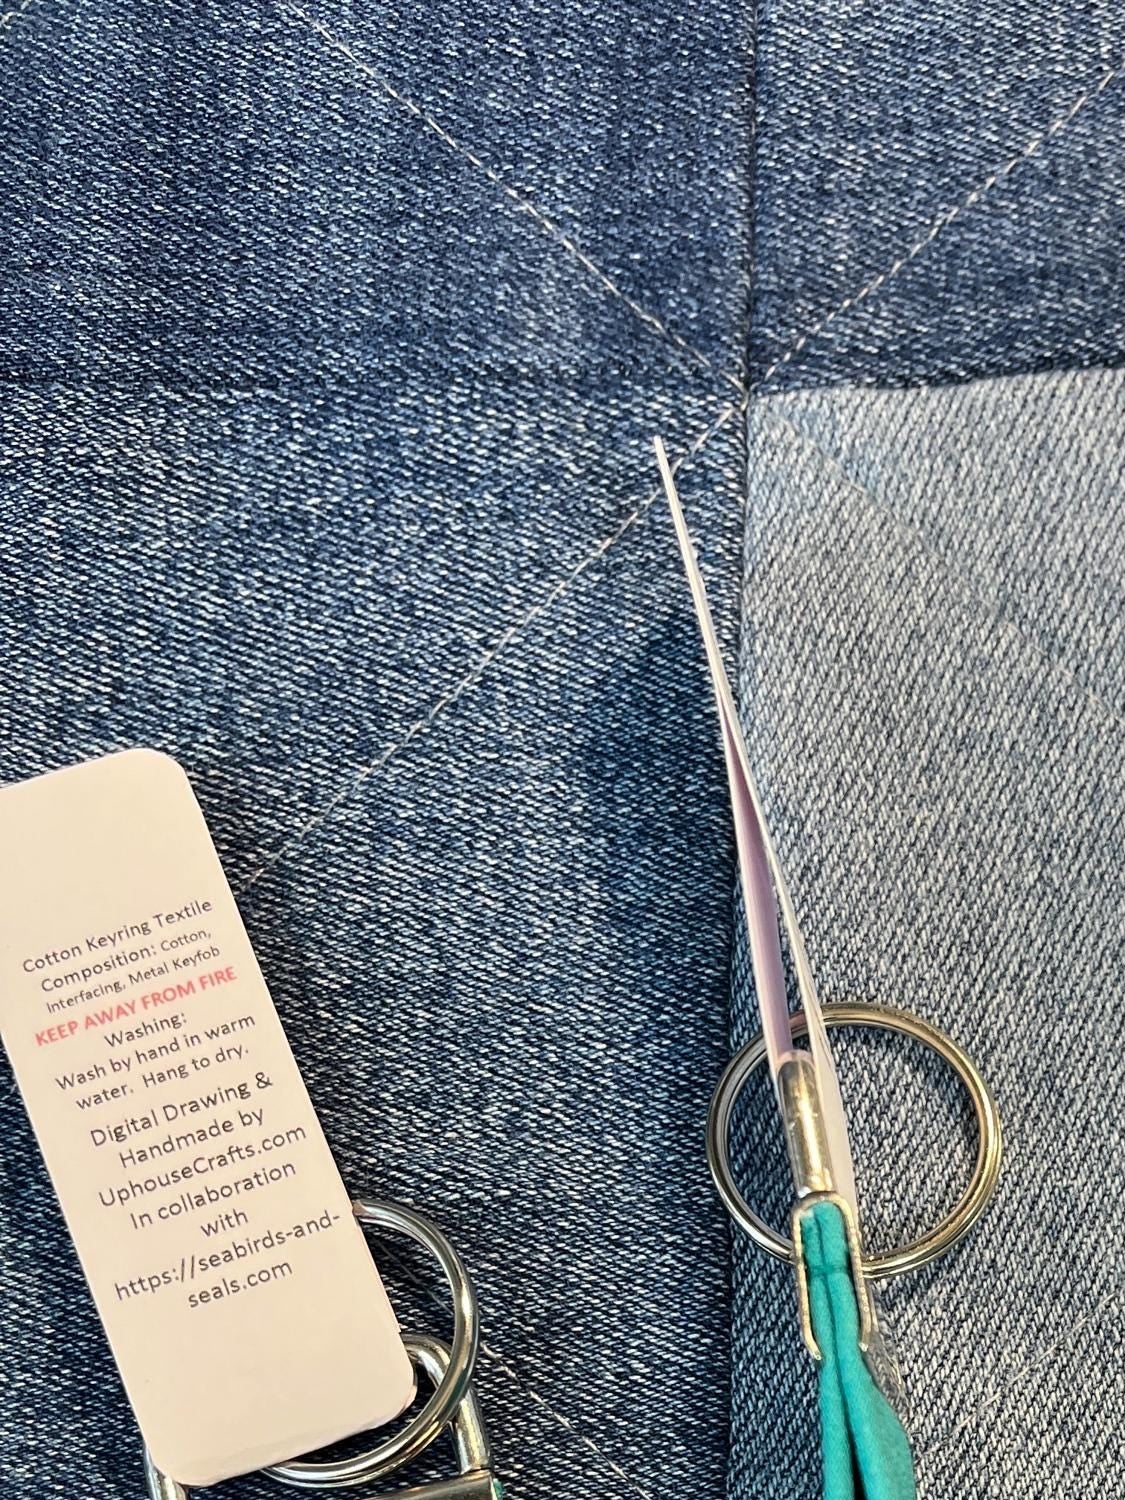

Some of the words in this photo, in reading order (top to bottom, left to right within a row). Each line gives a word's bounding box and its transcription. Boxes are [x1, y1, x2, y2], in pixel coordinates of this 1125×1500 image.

[23, 945, 82, 972] Cotton
[86, 921, 151, 951] Keyring
[153, 900, 213, 928] Textile
[41, 945, 157, 992] Composition:
[160, 929, 211, 951] Cotton,
[35, 1020, 78, 1046] KEEP
[84, 1000, 136, 1029] AWAY
[141, 981, 196, 1009] FROM
[199, 966, 237, 990] FIRE
[47, 981, 126, 1013] Interfacing,
[128, 962, 169, 984] Metal
[173, 946, 220, 970] Keyfob
[55, 1064, 106, 1090] Wash
[109, 1057, 131, 1073] by
[135, 1038, 180, 1064] hand
[185, 1034, 201, 1047] in
[204, 1015, 255, 1039] warm
[104, 1012, 187, 1047] Washing:
[76, 1083, 134, 1110] water.
[142, 1064, 188, 1088] Hang
[191, 1057, 210, 1070] to
[215, 1045, 248, 1063] dry.
[90, 1110, 159, 1146] Digital
[163, 1083, 251, 1121] Drawing
[255, 1071, 273, 1088] &
[99, 1126, 307, 1206] UphouseCrafts.com
[119, 1120, 234, 1168] Handmade
[238, 1109, 264, 1126] by
[130, 1212, 152, 1229] In
[158, 1162, 296, 1220] collaboration
[201, 1209, 248, 1236] with
[114, 1210, 340, 1300] https://seabirds-and-
[188, 1261, 292, 1308] seals.com
